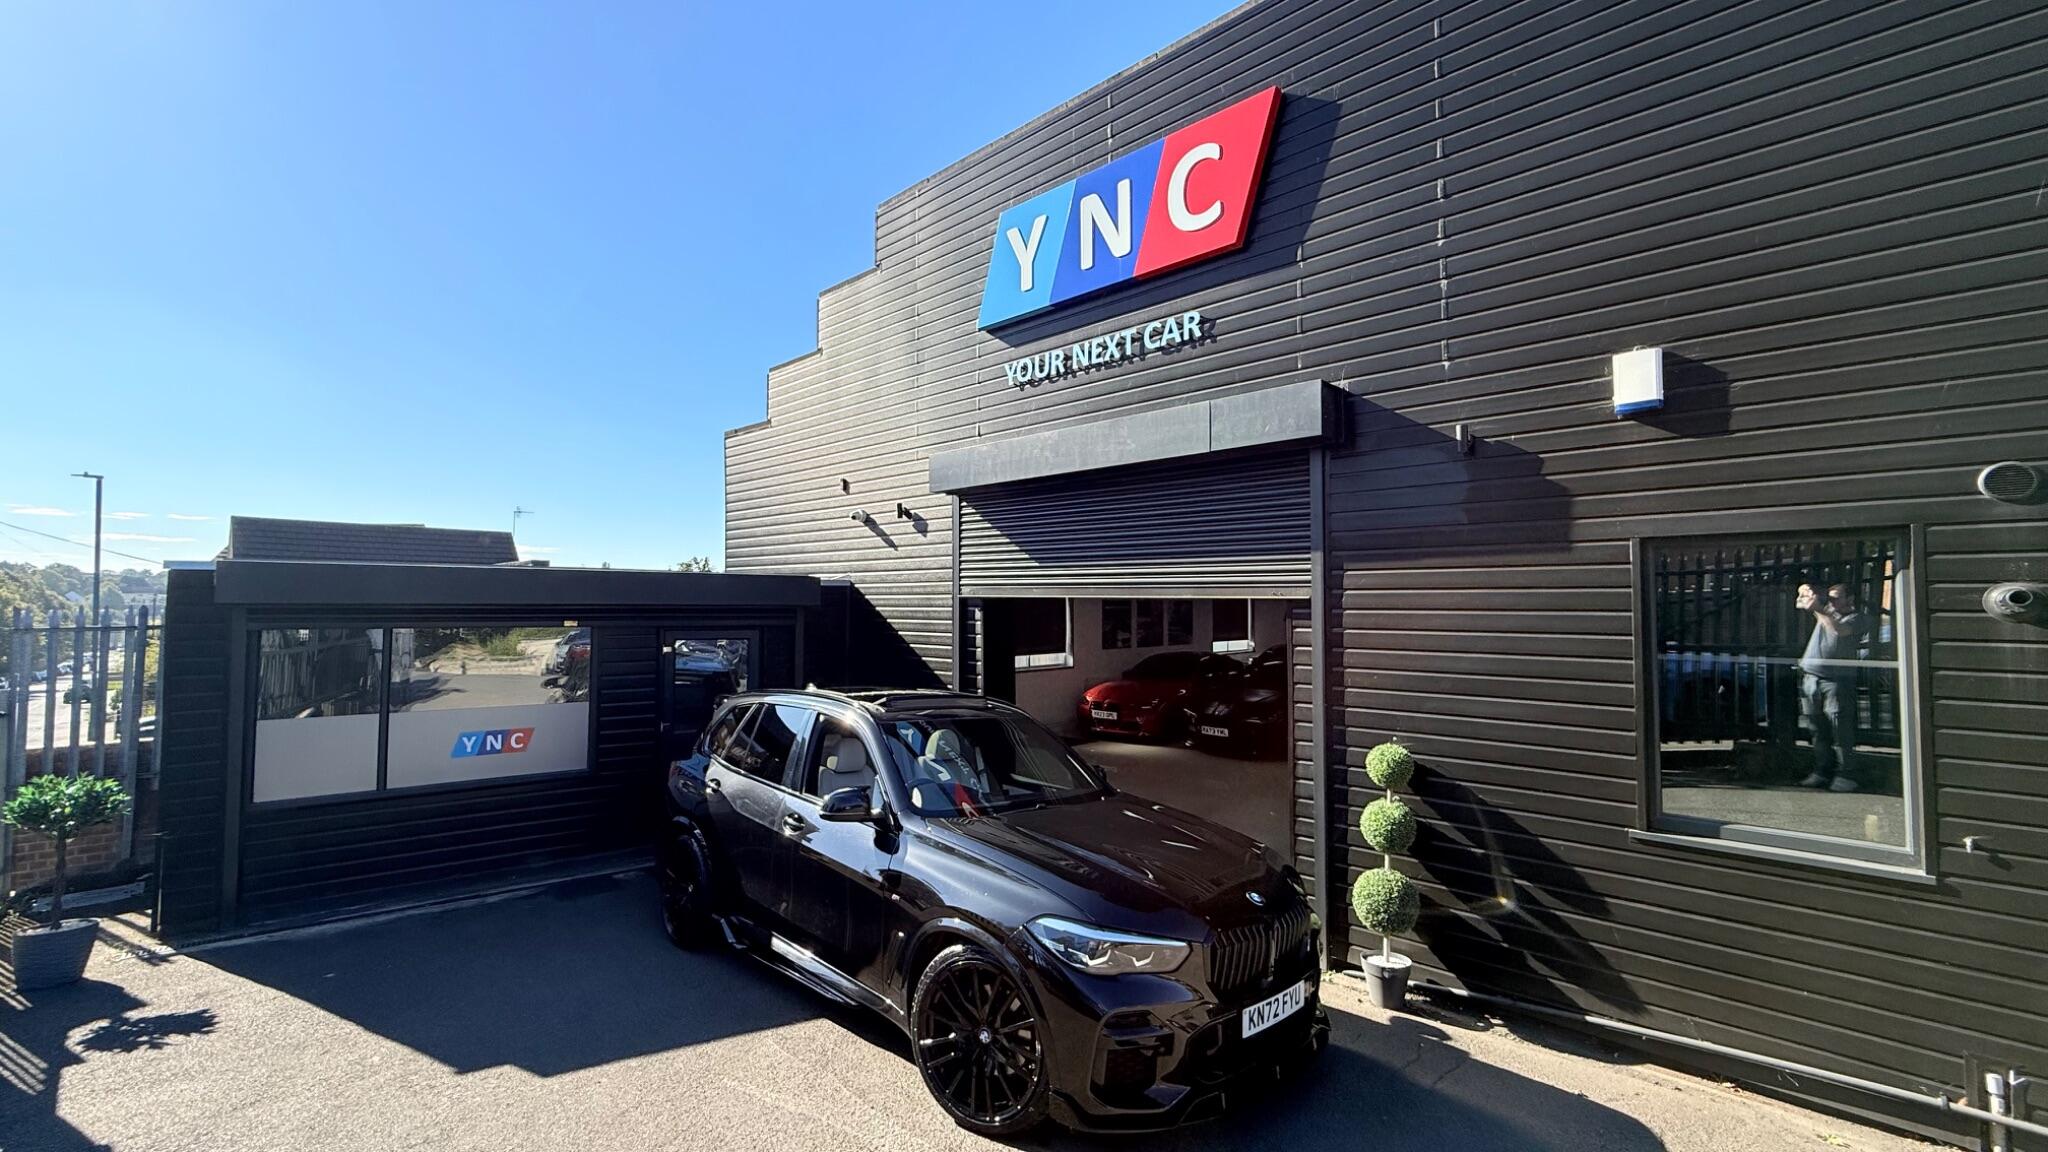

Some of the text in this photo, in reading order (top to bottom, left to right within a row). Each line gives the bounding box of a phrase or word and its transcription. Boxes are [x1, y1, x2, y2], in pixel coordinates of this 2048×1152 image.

[1006, 142, 1222, 292] YNC
[1004, 311, 1201, 386] YOUR NEXT CAR
[461, 732, 525, 753] YNC
[1248, 984, 1302, 1031] KN72 FYU
